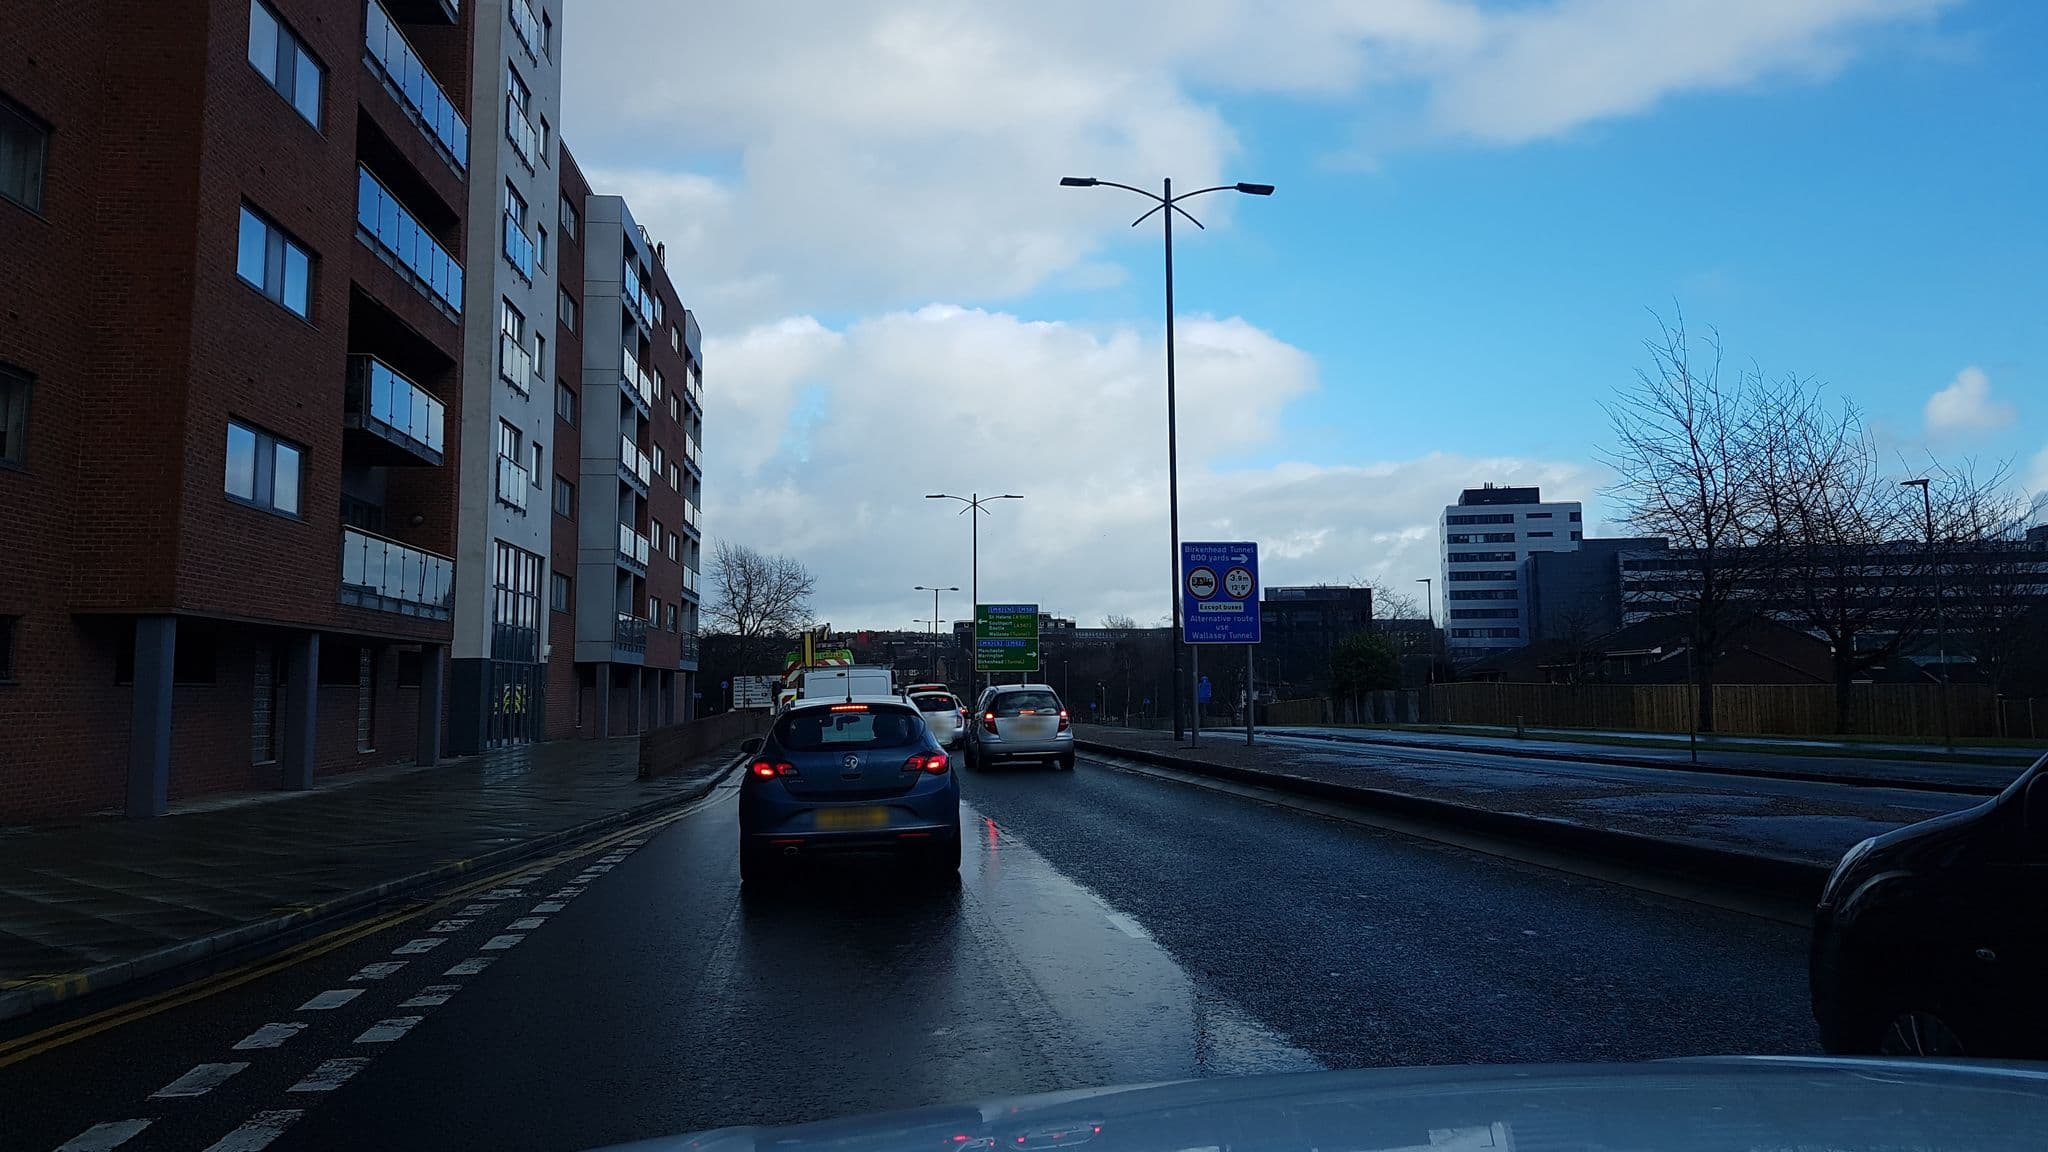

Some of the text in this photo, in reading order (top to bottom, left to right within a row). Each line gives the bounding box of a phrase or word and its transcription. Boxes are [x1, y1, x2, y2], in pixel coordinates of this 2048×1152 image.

[1184, 545, 1254, 553] Birkenhead Tunnel
[1208, 554, 1230, 562] yards
[1200, 603, 1223, 611] Except
[1192, 632, 1226, 640] Wallasey
